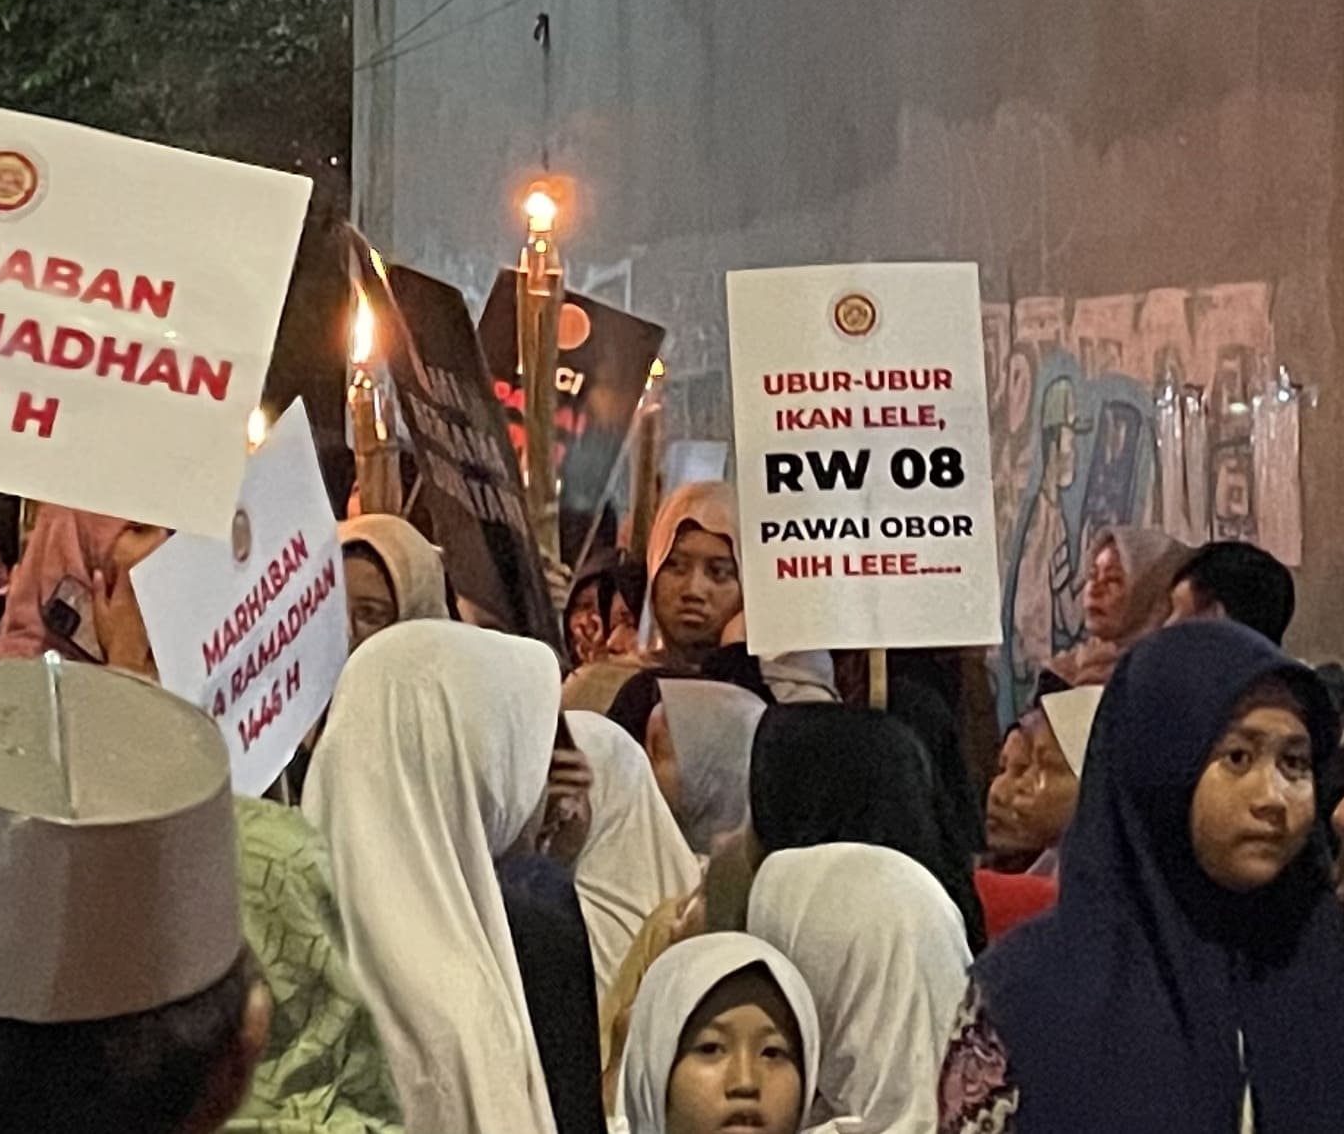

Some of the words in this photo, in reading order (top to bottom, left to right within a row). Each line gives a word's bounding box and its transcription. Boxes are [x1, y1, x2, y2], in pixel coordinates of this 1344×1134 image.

[762, 368, 953, 396] UBUR-UBUR
[10, 390, 61, 440] H
[775, 408, 853, 431] IKAN
[862, 404, 947, 431] LELE,
[764, 449, 871, 495] RW
[890, 446, 966, 490] 08
[760, 518, 871, 545] PAWAI
[880, 515, 974, 539] OBOR
[775, 555, 833, 580] NIH
[201, 529, 310, 676] MARHABAN
[231, 558, 337, 704] RAMADHAN
[238, 678, 283, 755] 1446
[286, 659, 301, 701] H
